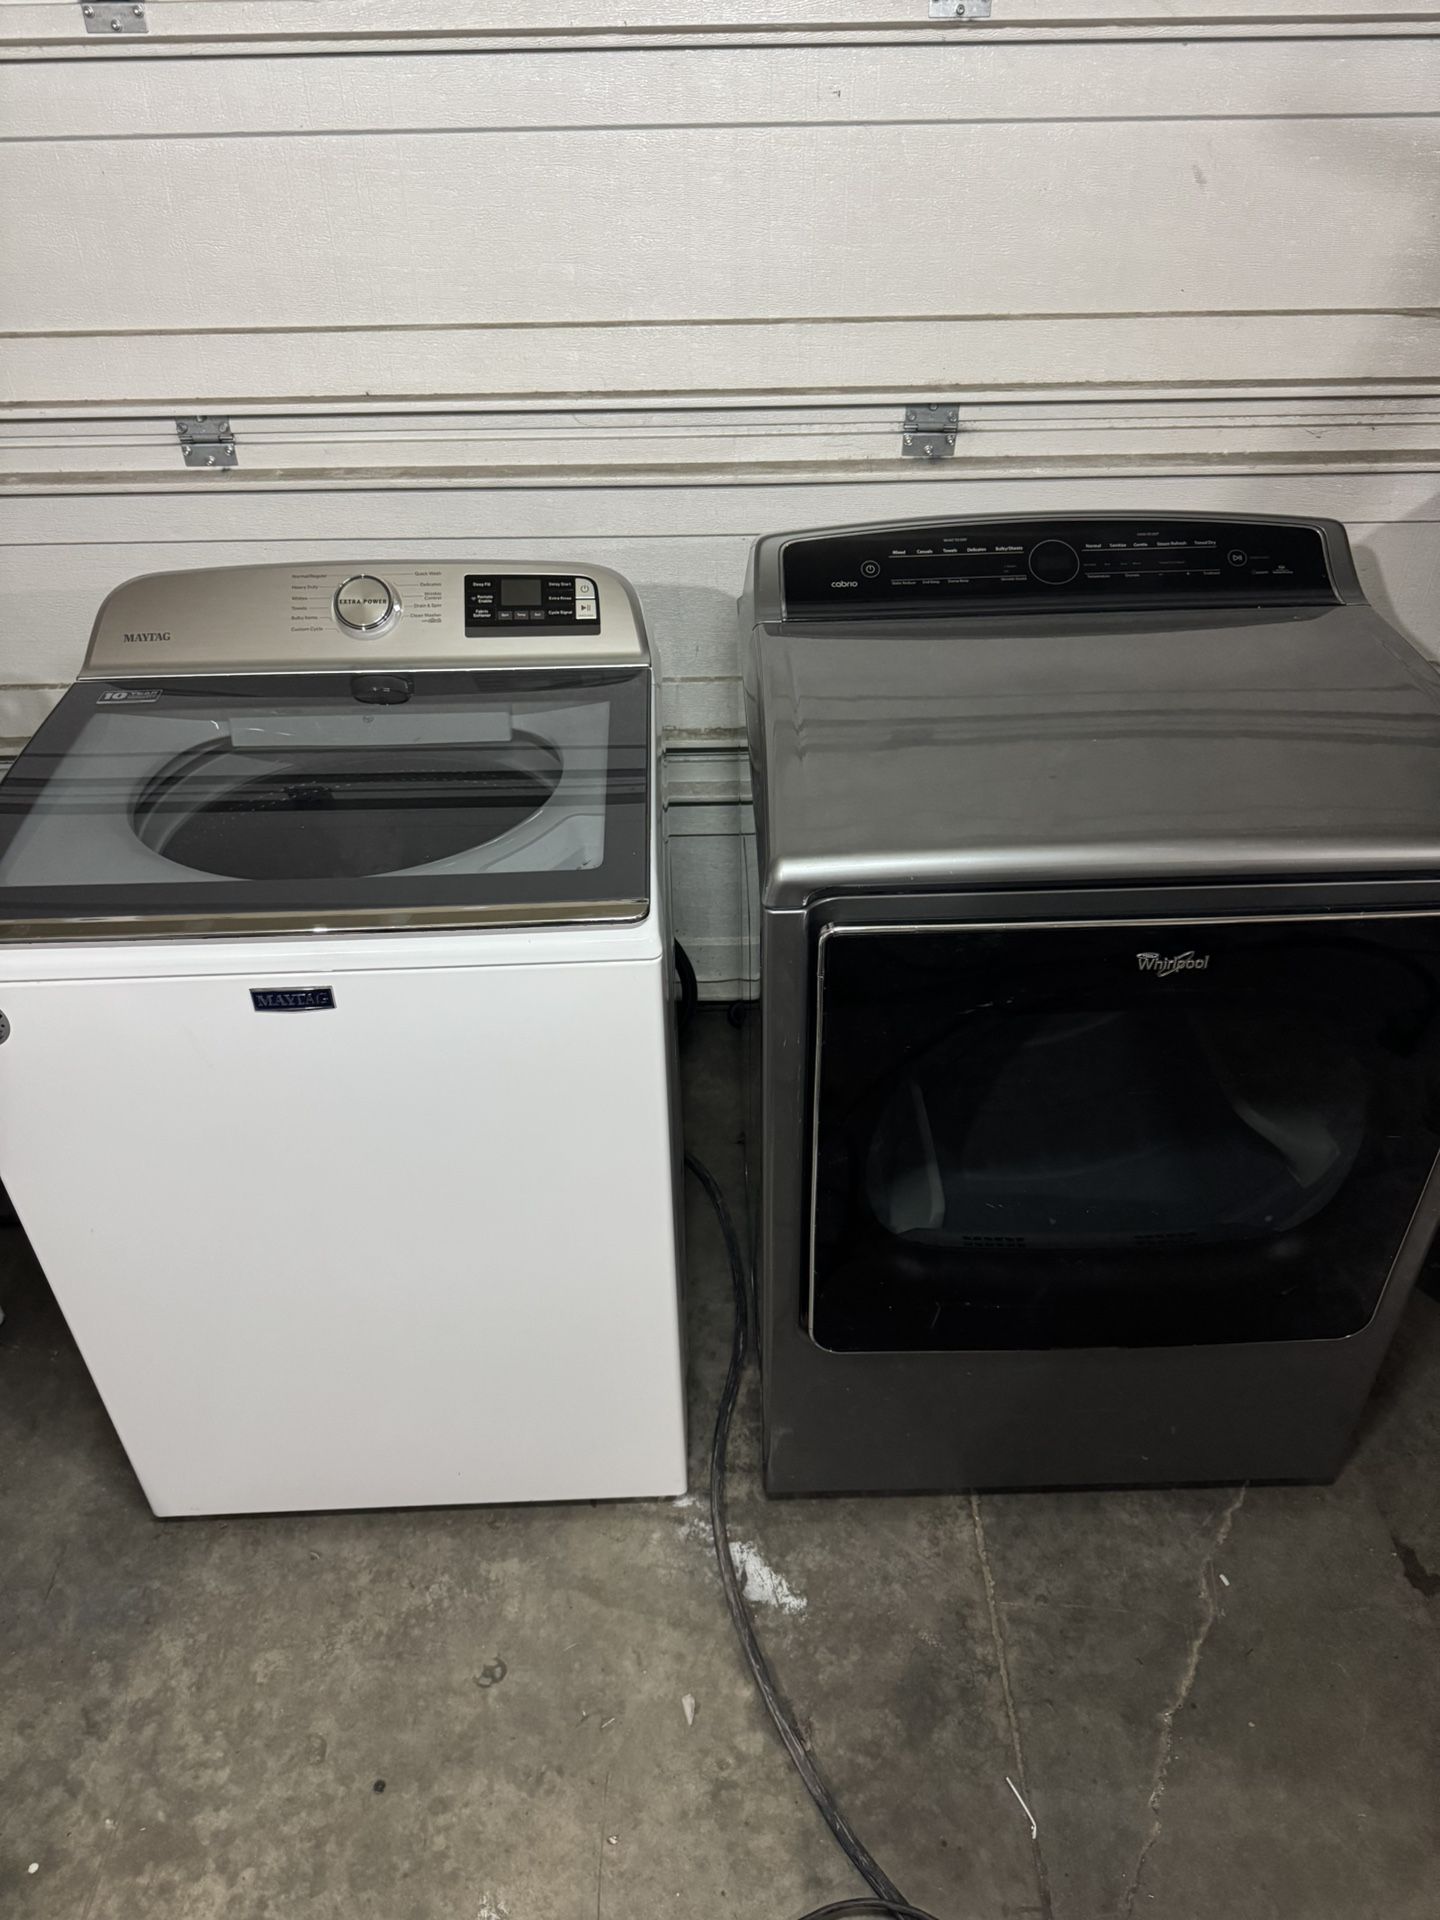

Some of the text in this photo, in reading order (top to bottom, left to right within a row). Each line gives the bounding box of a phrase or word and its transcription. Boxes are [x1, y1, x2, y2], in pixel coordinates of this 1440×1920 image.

[831, 580, 858, 588] cabrio
[123, 632, 171, 643] MAYTAG
[104, 692, 128, 700] 10
[1136, 951, 1210, 977] Whirlpool
[256, 992, 329, 1007] MAYTAG
